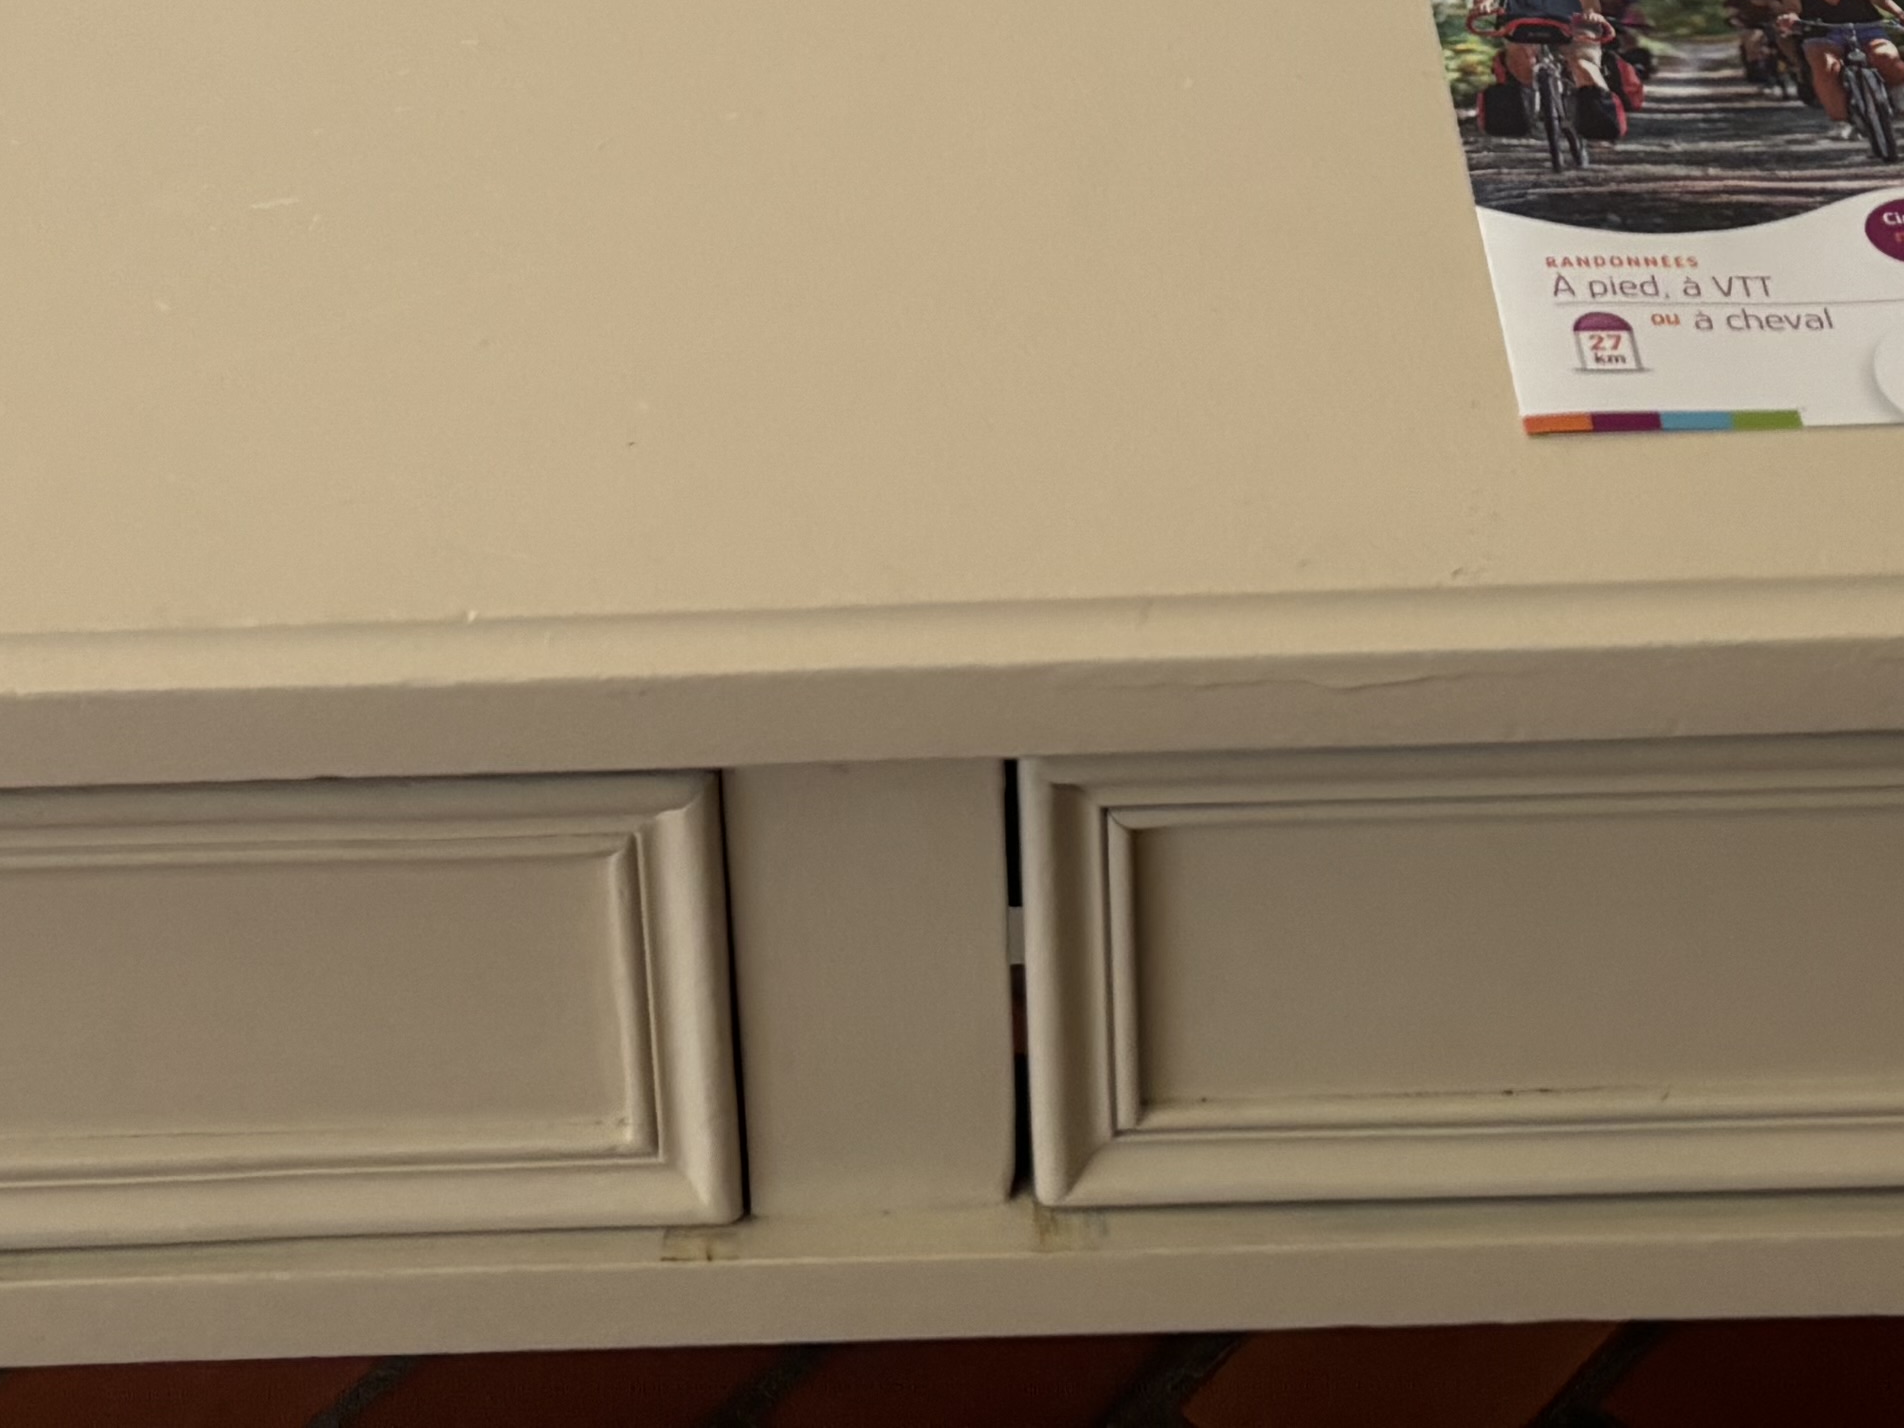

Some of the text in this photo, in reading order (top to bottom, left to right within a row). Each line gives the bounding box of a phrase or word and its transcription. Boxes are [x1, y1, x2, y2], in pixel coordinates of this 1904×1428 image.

[1545, 254, 1698, 268] RANDONNÉES
[1588, 275, 1669, 300] pied,
[1683, 275, 1702, 298] à
[1712, 275, 1772, 298] VTT
[1651, 308, 1834, 331] ou à cheval
[1589, 335, 1623, 351] 27
[1593, 351, 1627, 365] km
